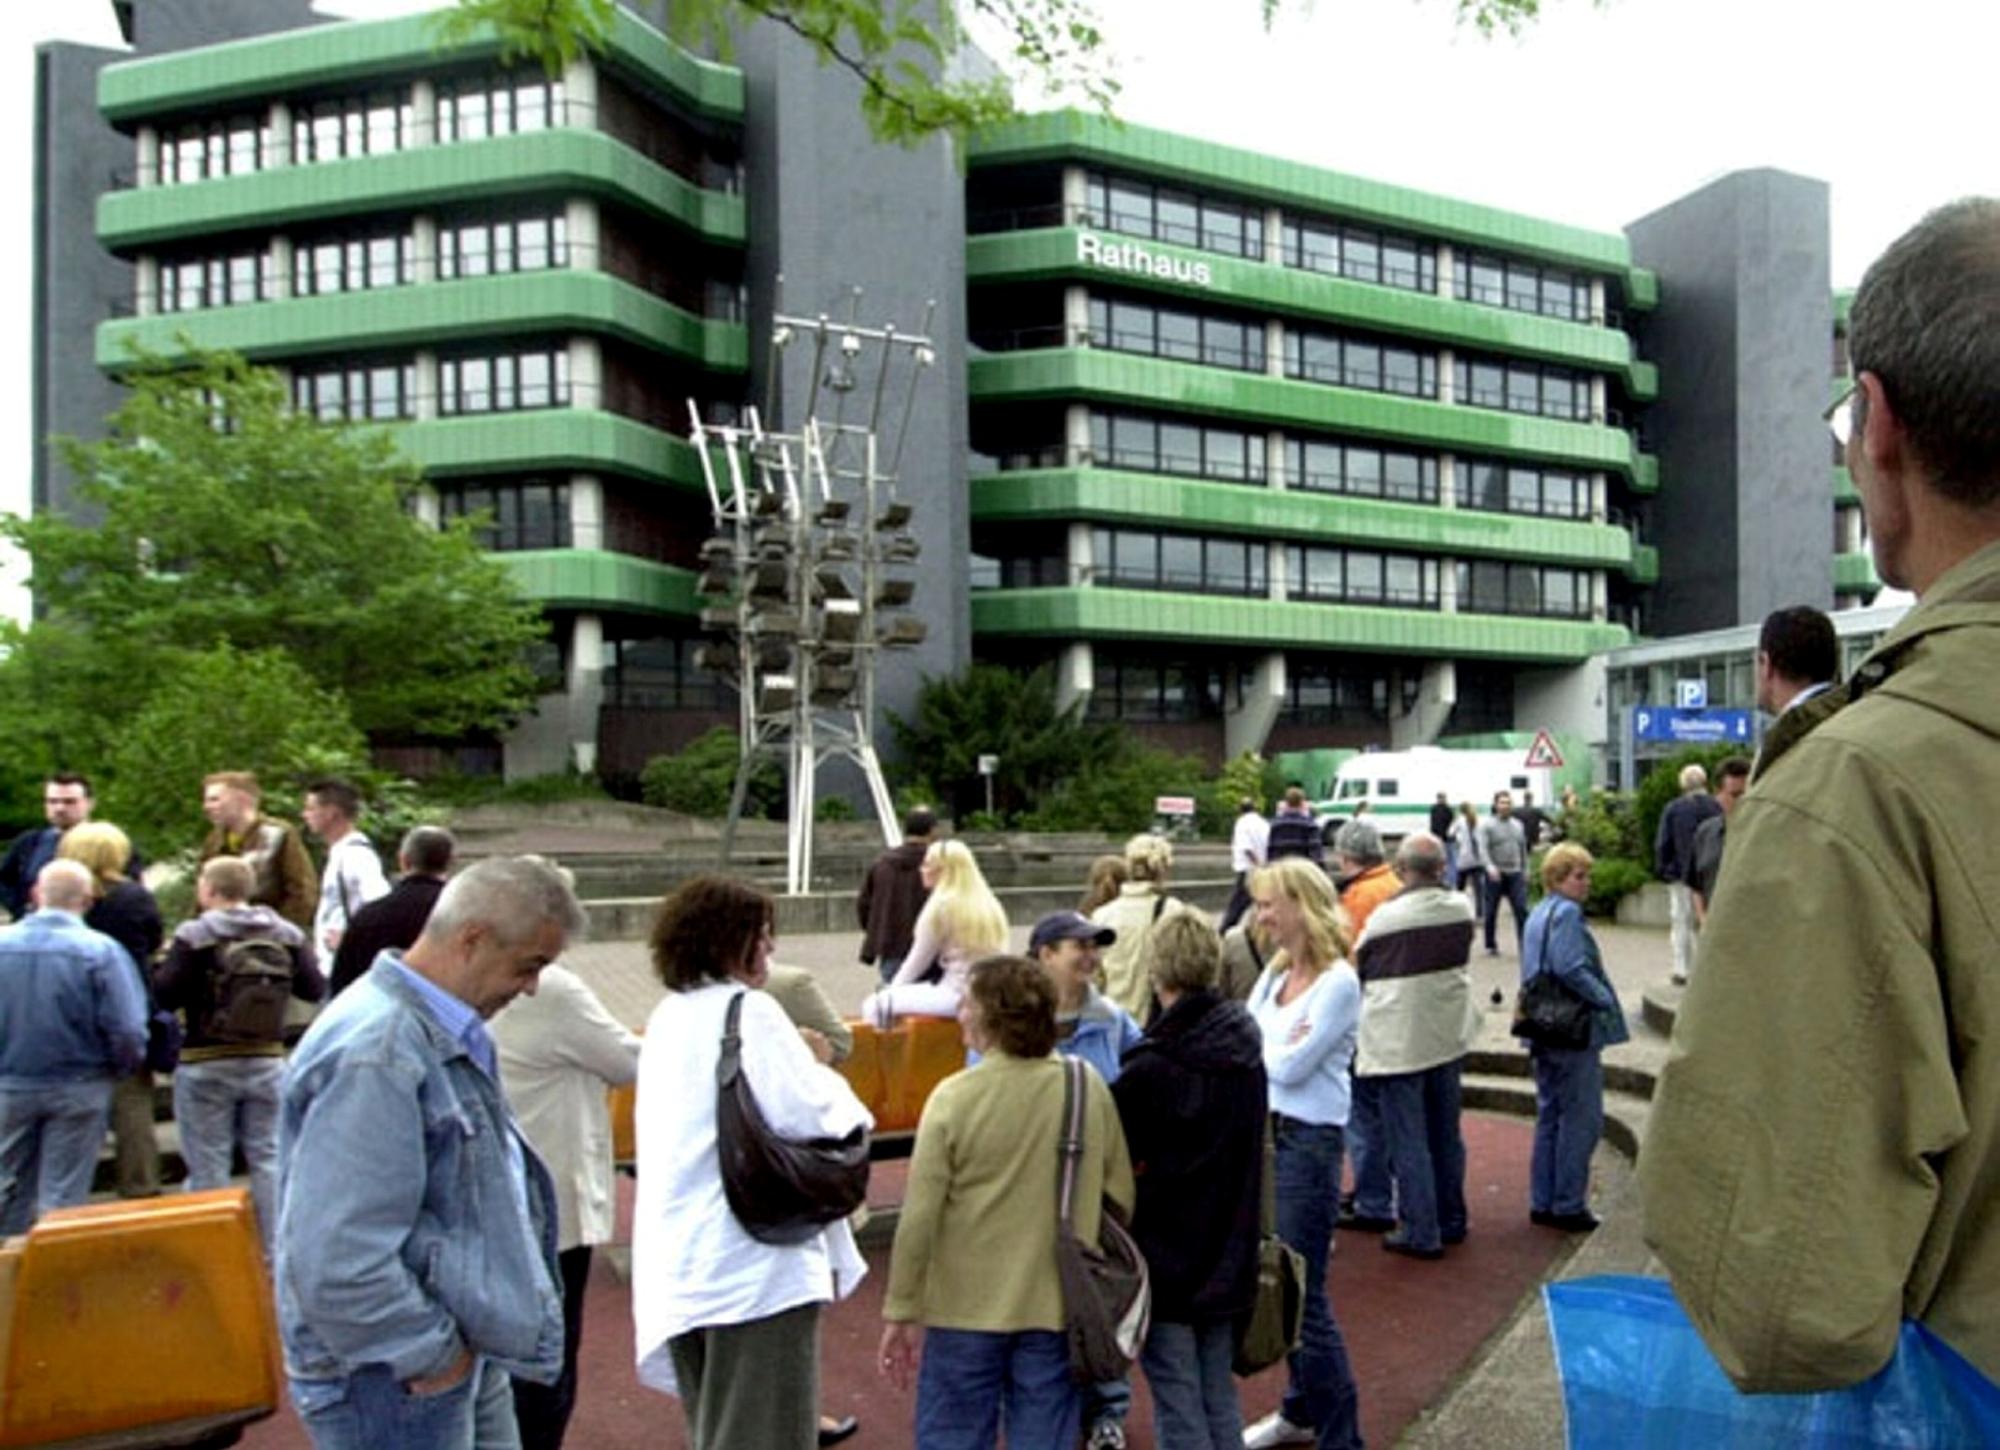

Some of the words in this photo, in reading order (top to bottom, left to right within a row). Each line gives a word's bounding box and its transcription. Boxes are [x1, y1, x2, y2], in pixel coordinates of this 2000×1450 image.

[1077, 232, 1211, 284] Rathaus
[1683, 682, 1702, 706] P
[1637, 713, 1650, 734] P
